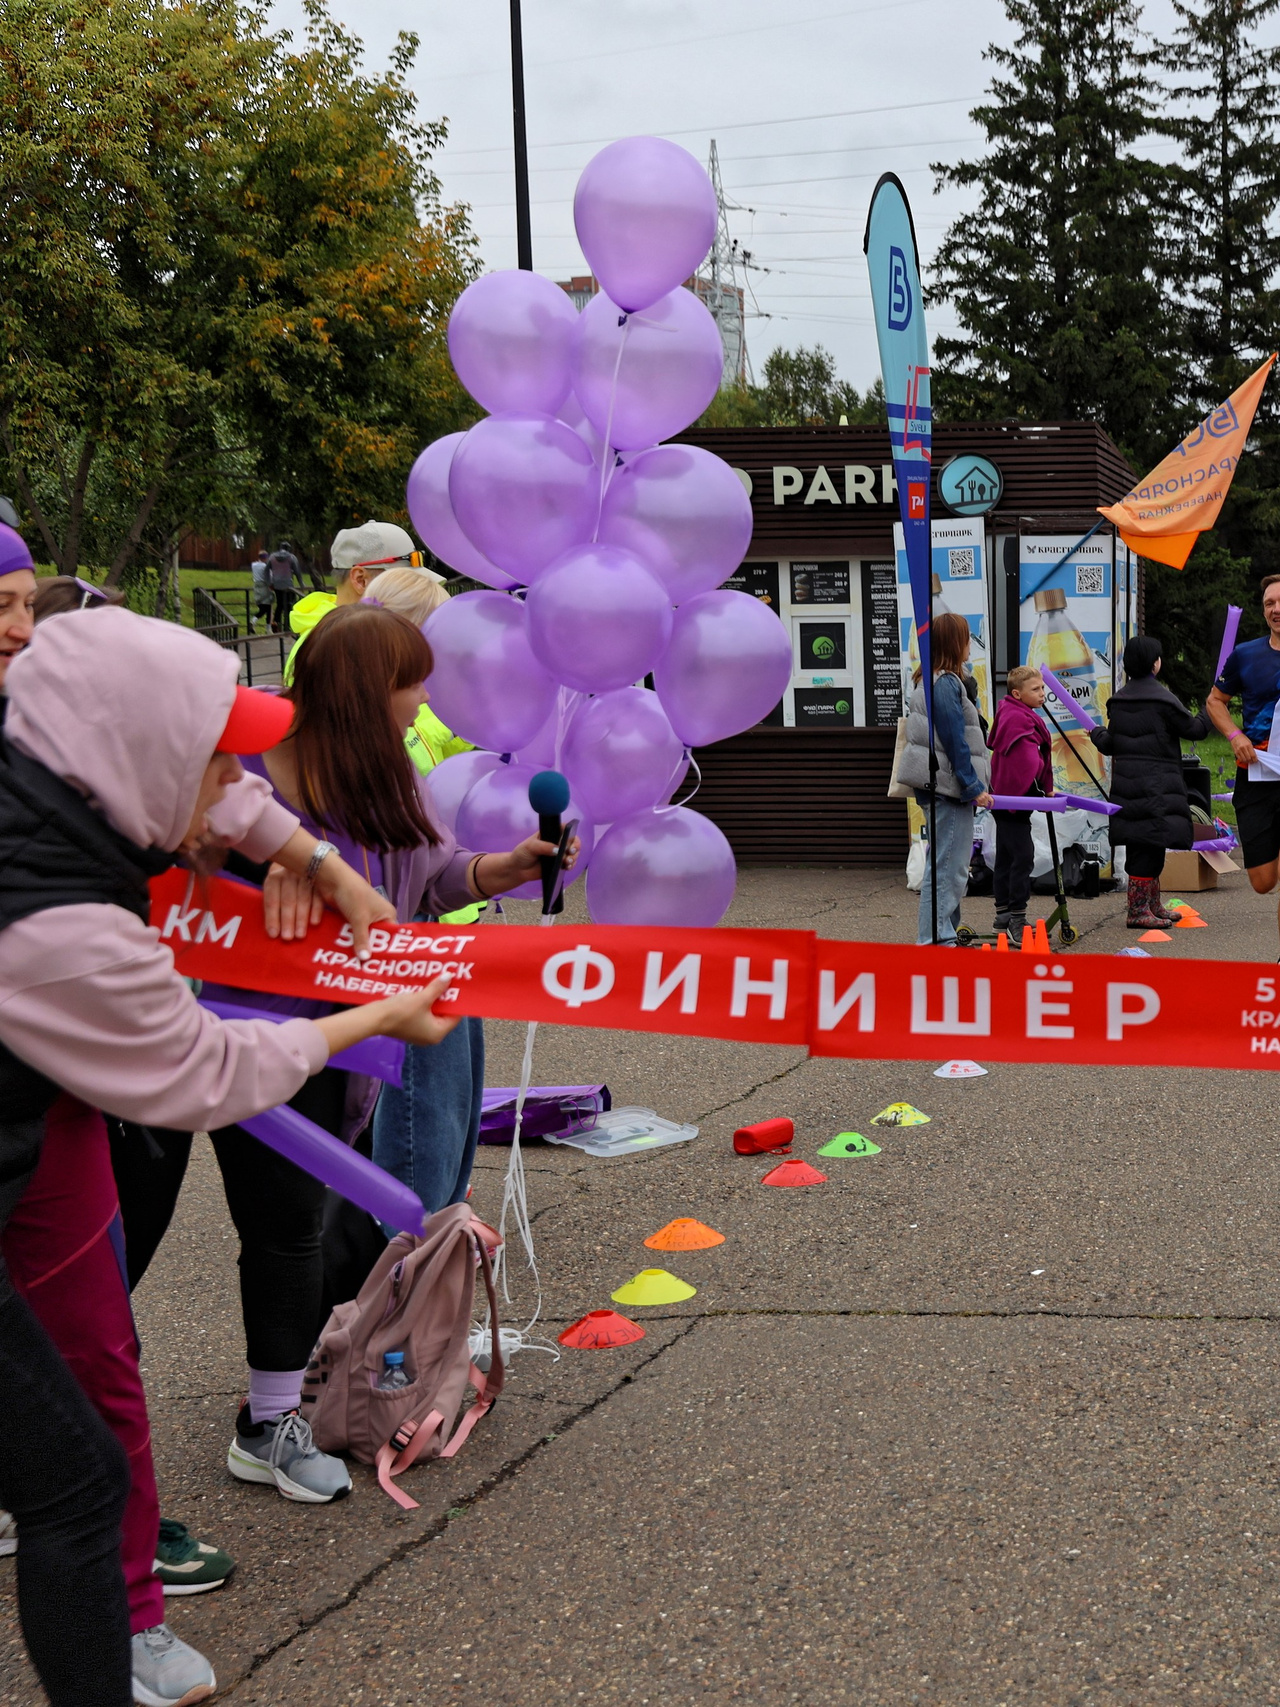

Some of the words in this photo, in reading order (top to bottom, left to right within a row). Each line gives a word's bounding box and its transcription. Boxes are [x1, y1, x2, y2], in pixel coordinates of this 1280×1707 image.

[1044, 686, 1090, 704] ОАРИ
[162, 904, 242, 949] КМ
[333, 923, 356, 948] 5
[368, 924, 476, 955] ВЁРСТ
[312, 948, 475, 980] КРАСНОЯРСК
[315, 970, 460, 1002] НАБЕРЕЖЯ
[1255, 977, 1276, 1003] 5
